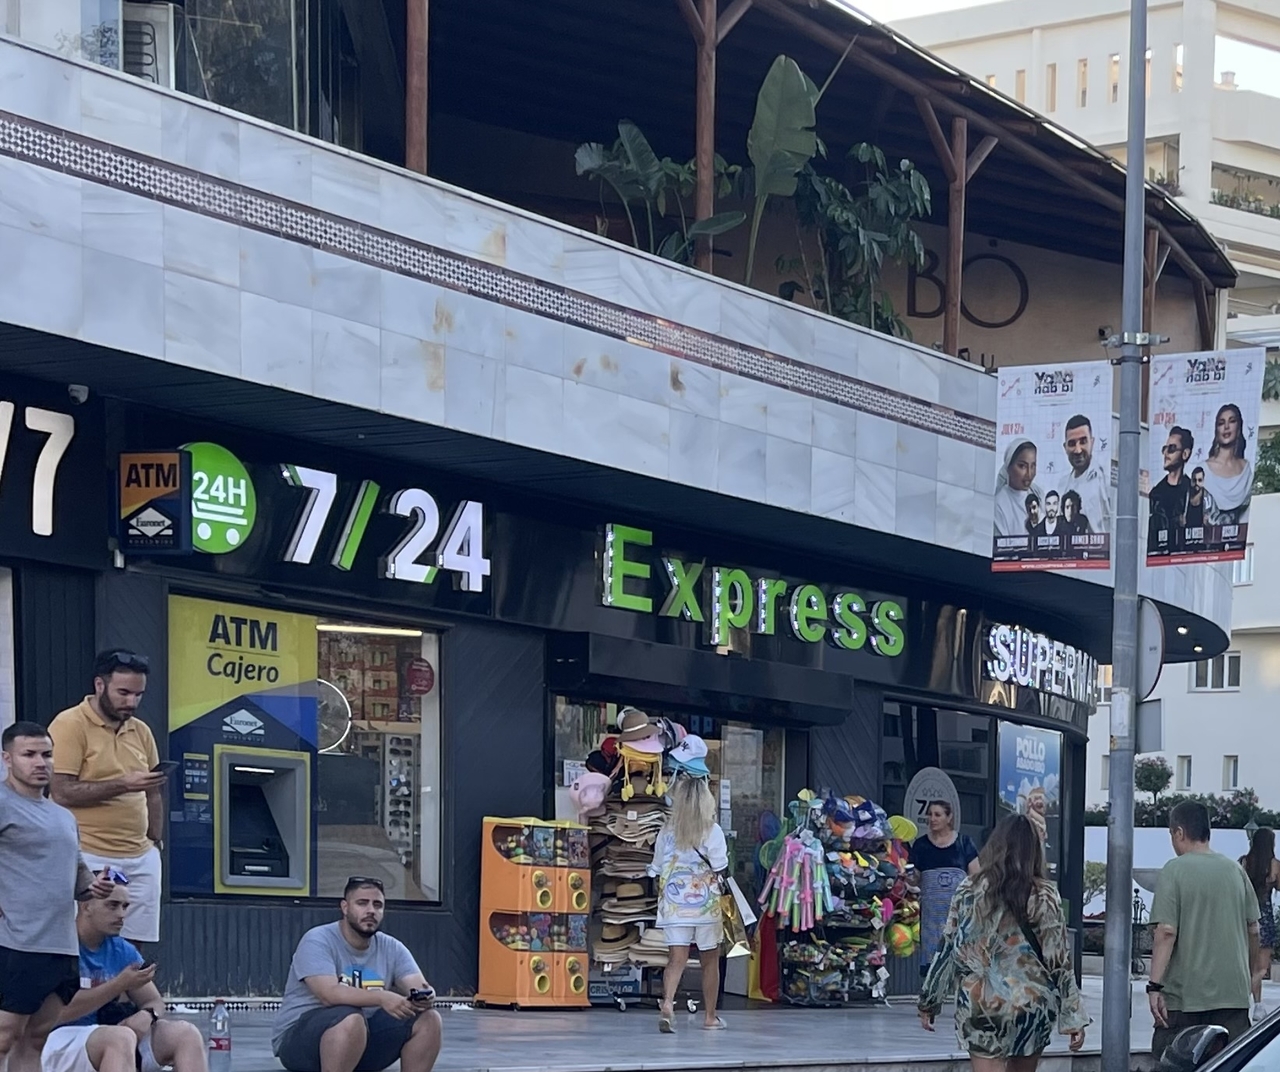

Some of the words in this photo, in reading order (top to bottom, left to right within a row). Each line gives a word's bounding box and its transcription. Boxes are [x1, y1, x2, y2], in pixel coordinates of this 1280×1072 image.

[125, 463, 177, 488] ATM
[193, 471, 247, 507] 24H
[280, 463, 491, 592] 7/24
[603, 523, 905, 657] Express
[208, 613, 278, 652] ATM
[207, 652, 279, 685] Cajero
[1016, 736, 1046, 762] POLLO
